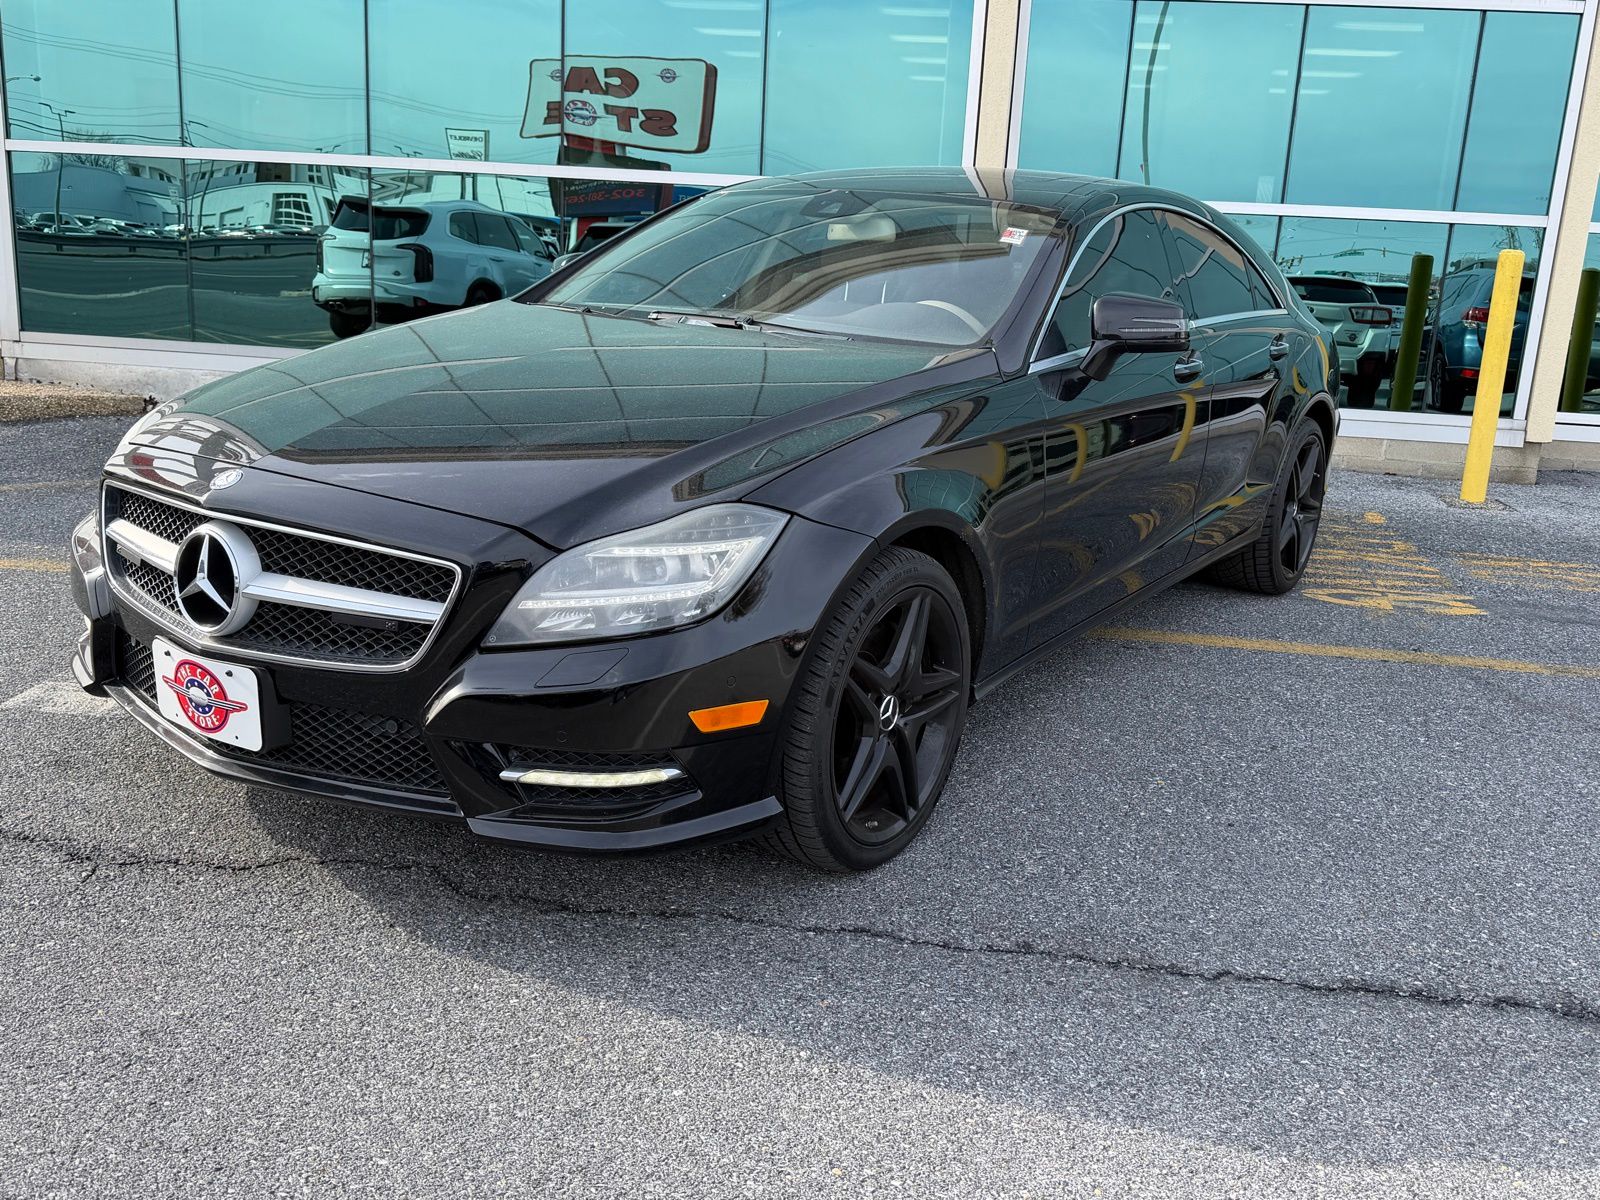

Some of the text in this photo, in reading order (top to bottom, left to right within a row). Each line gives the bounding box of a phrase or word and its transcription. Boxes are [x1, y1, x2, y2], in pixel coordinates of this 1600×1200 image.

[177, 665, 219, 692] THE CAR
[187, 708, 219, 727] STORE
